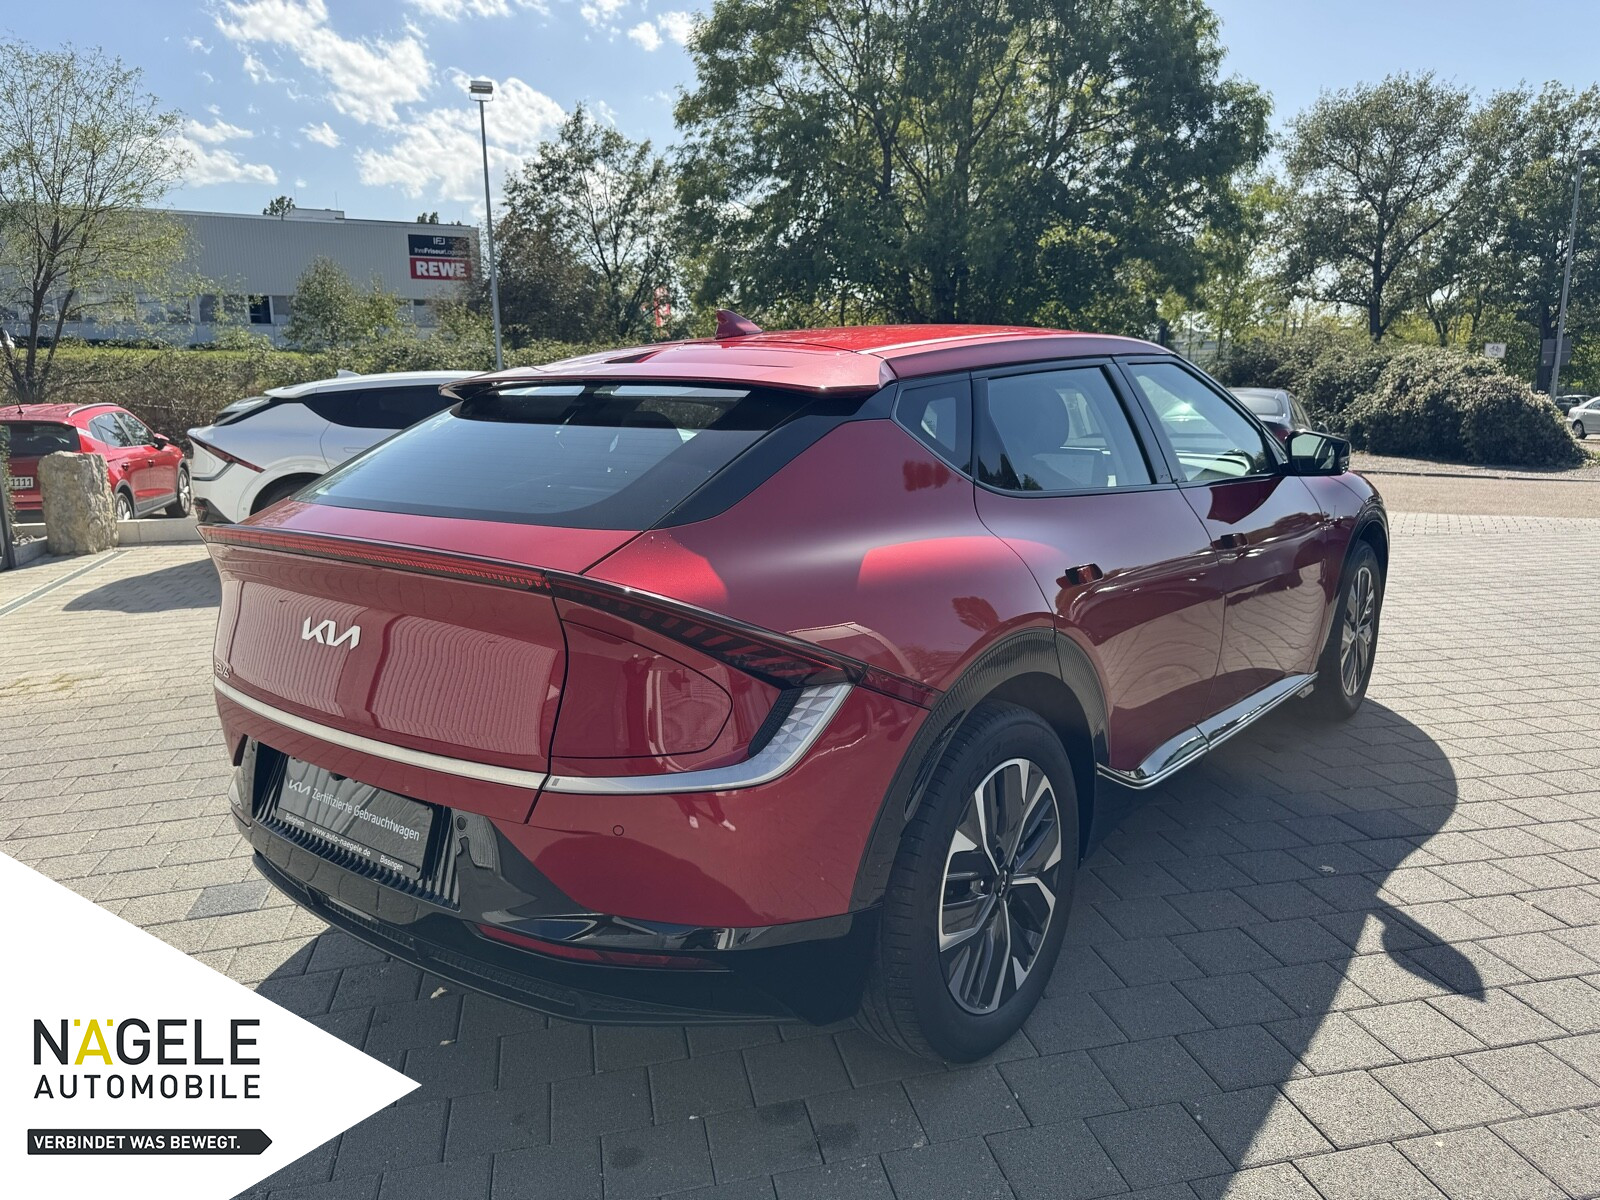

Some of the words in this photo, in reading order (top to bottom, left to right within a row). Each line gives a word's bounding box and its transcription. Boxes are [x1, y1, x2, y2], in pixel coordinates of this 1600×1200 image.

[415, 260, 466, 277] REWE
[301, 616, 361, 650] KIA
[215, 661, 231, 679] EV6
[288, 779, 311, 796] KIA
[312, 787, 353, 814] Zertifizierte
[353, 804, 420, 842] Gebrauchtwagen
[312, 826, 371, 857] www.auto-naegele.de
[379, 854, 404, 871] Bissingen
